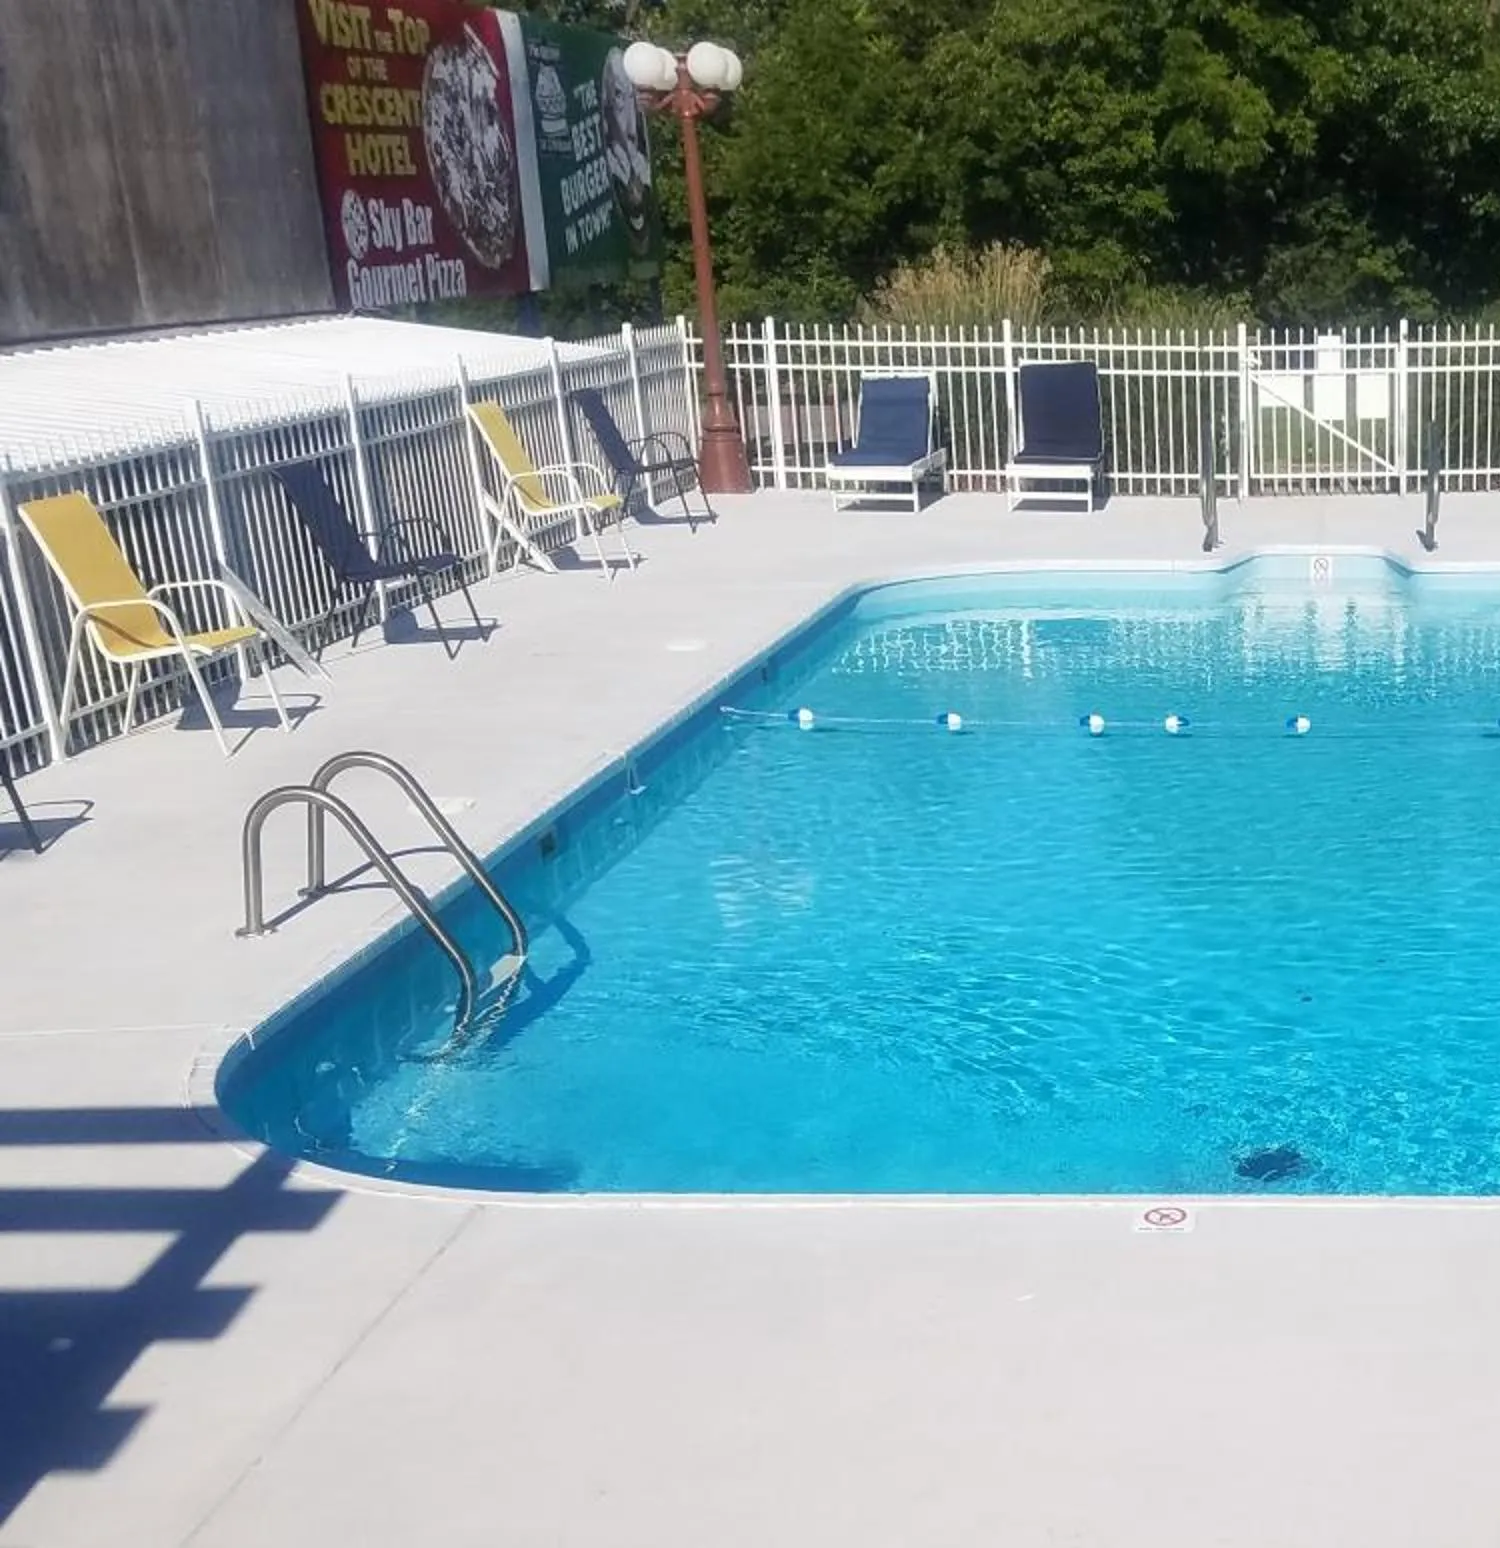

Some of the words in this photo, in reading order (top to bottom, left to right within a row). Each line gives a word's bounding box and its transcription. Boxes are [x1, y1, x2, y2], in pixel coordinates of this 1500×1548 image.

[308, 0, 371, 50] VISIT
[387, 8, 430, 55] TOP
[362, 58, 388, 81] THE
[320, 83, 422, 127] CRESCENT
[344, 132, 417, 176] HOTEL
[571, 112, 602, 162] BEST
[560, 156, 610, 216] BURGER
[368, 197, 402, 253] Sky
[402, 198, 434, 246] Bar
[347, 257, 426, 308] Gourmet
[425, 252, 467, 302] Pizza
